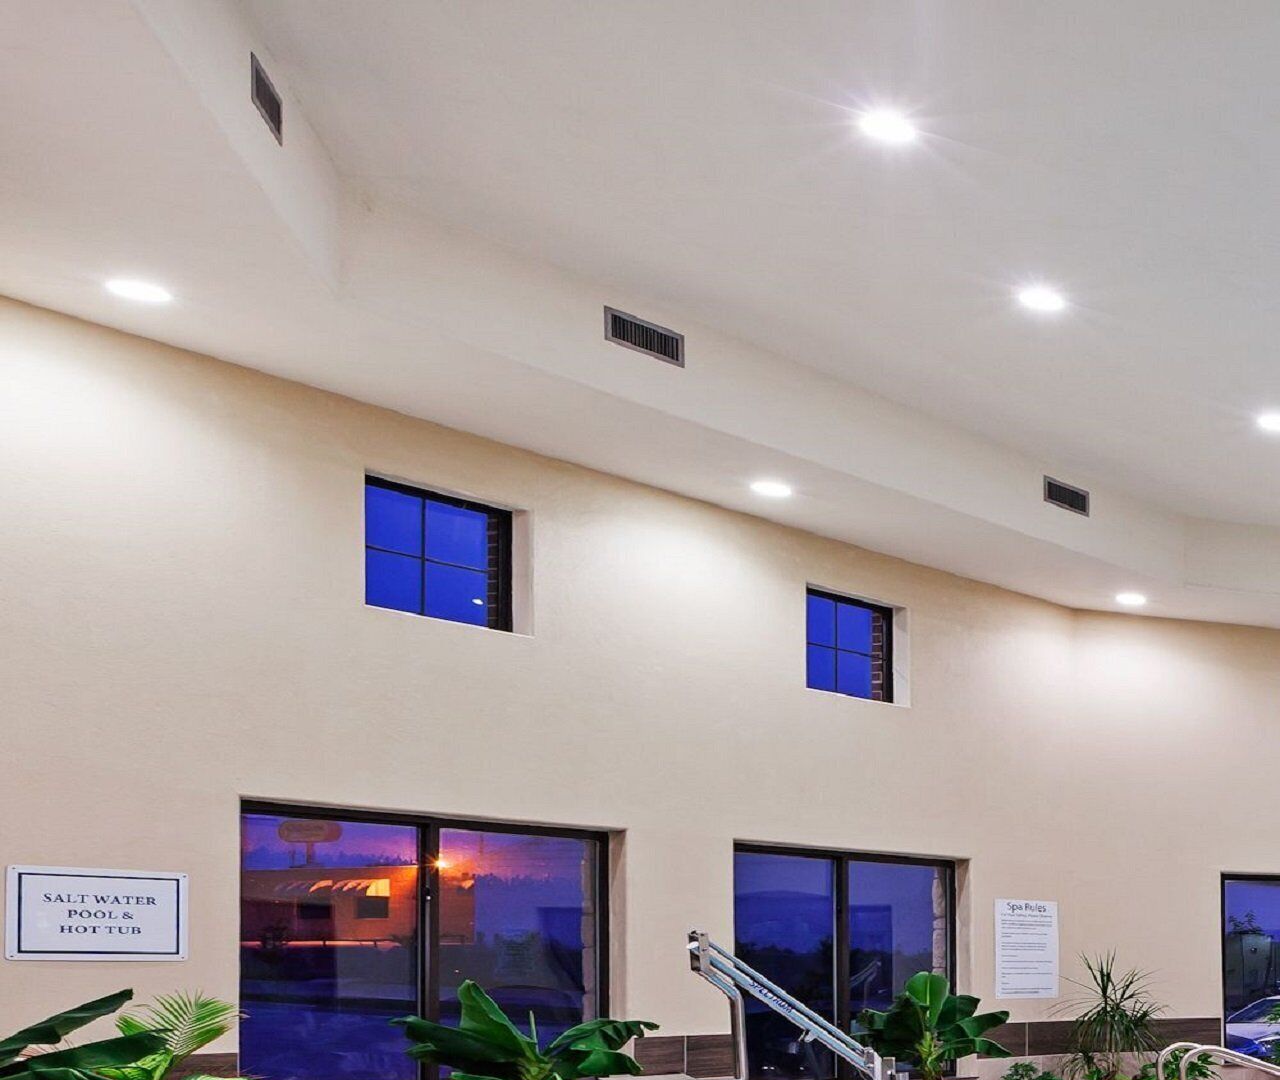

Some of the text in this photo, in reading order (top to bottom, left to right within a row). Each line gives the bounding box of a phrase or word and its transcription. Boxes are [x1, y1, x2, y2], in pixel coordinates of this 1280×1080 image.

[42, 893, 158, 906] SALT WATER
[1007, 902, 1047, 913] Spa Rules
[68, 909, 134, 920] POOL &
[60, 925, 142, 935] HOT TUB
